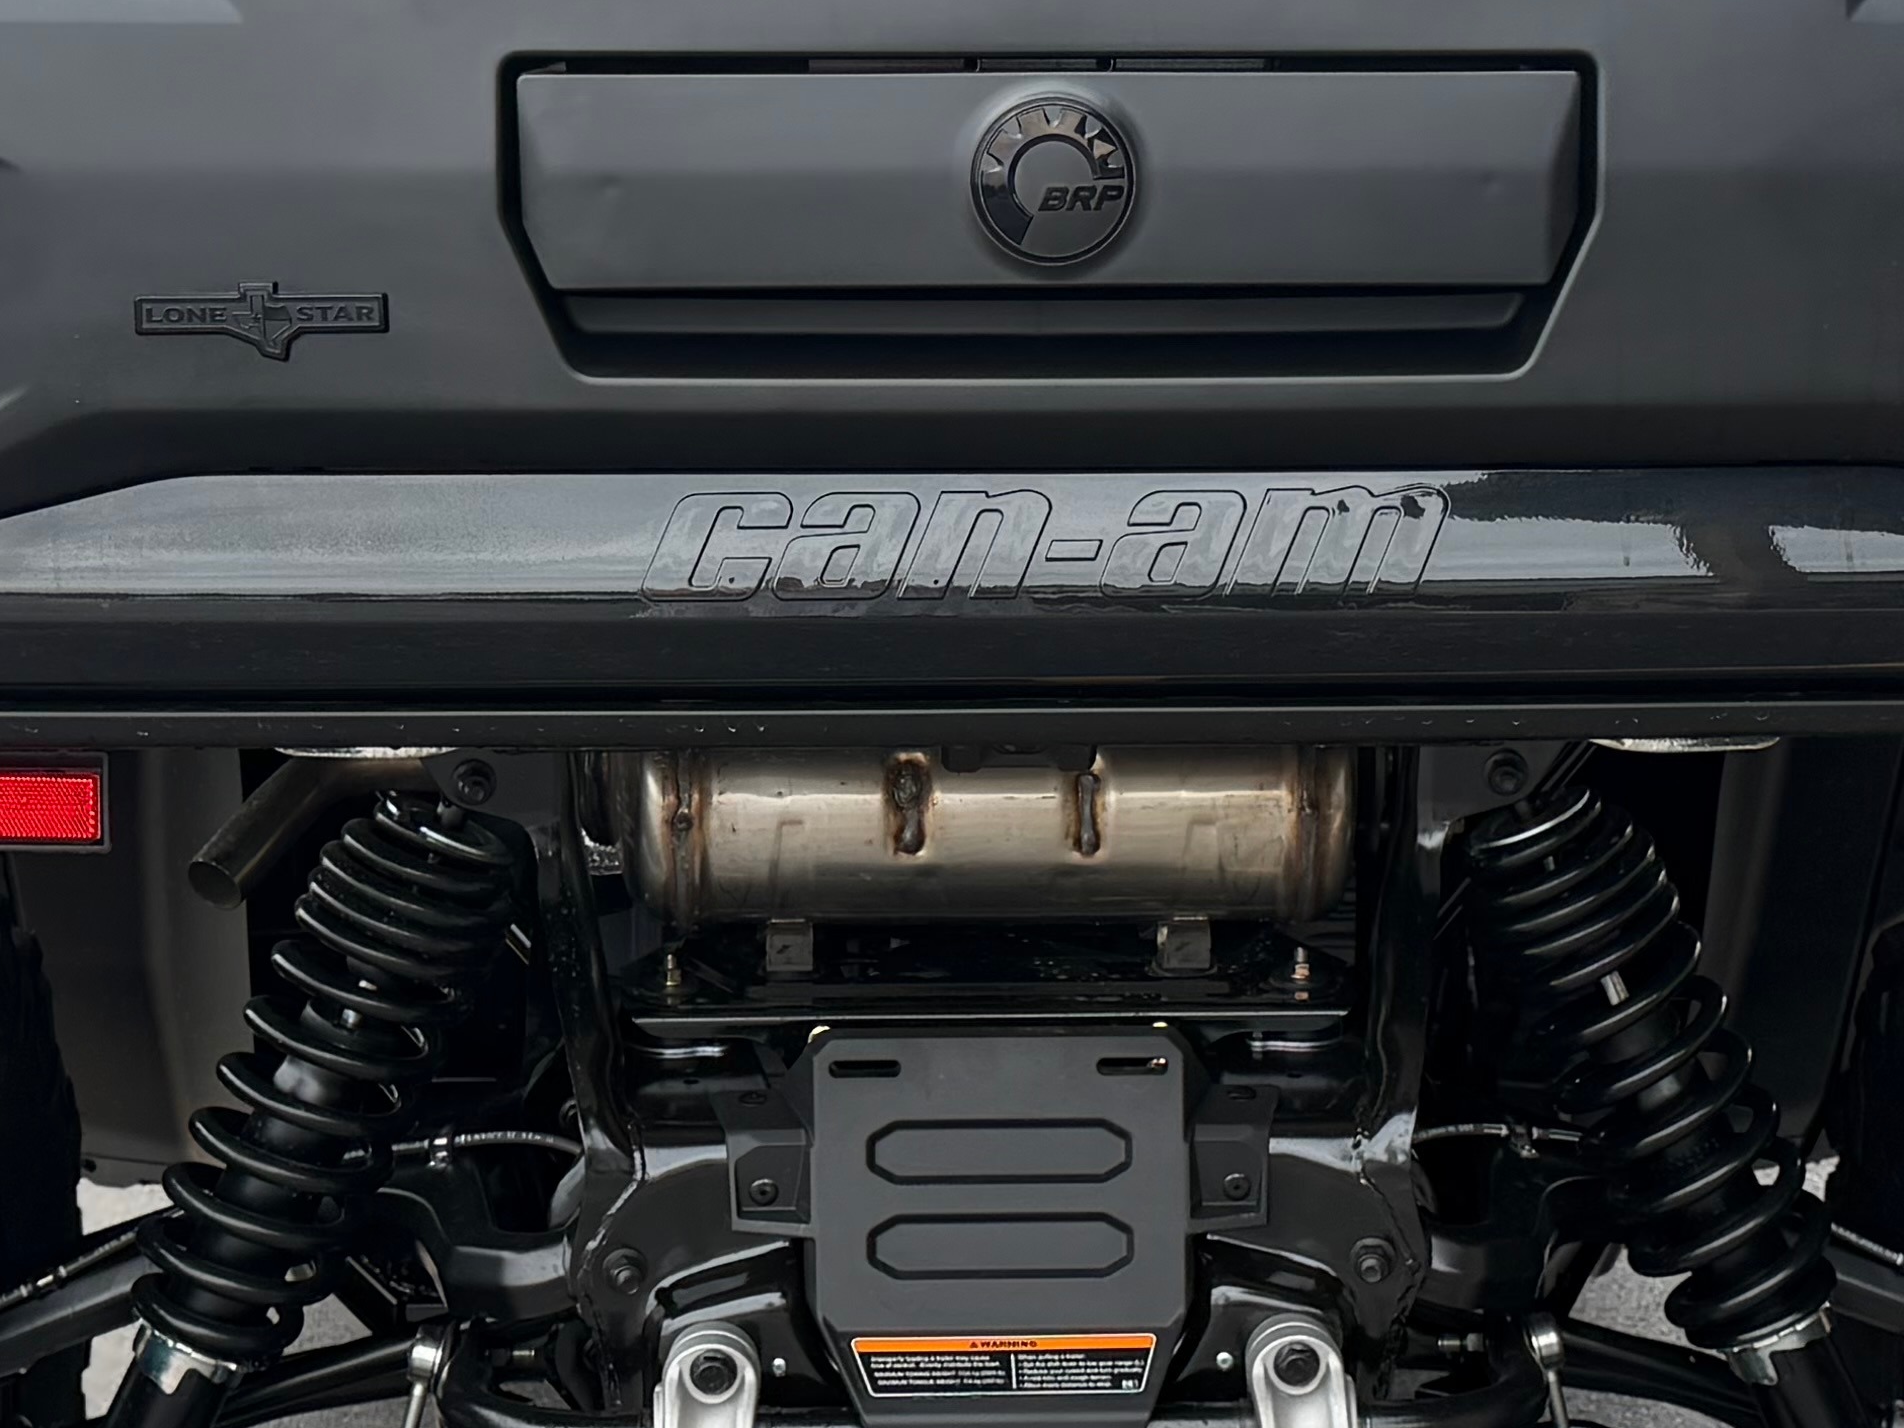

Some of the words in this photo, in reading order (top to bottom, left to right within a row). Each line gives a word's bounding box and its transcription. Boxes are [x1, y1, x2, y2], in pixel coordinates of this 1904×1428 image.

[1037, 185, 1125, 212] BRP
[146, 305, 227, 323] LONE
[295, 304, 375, 323] STAR
[980, 1340, 1038, 1349] WARNING
